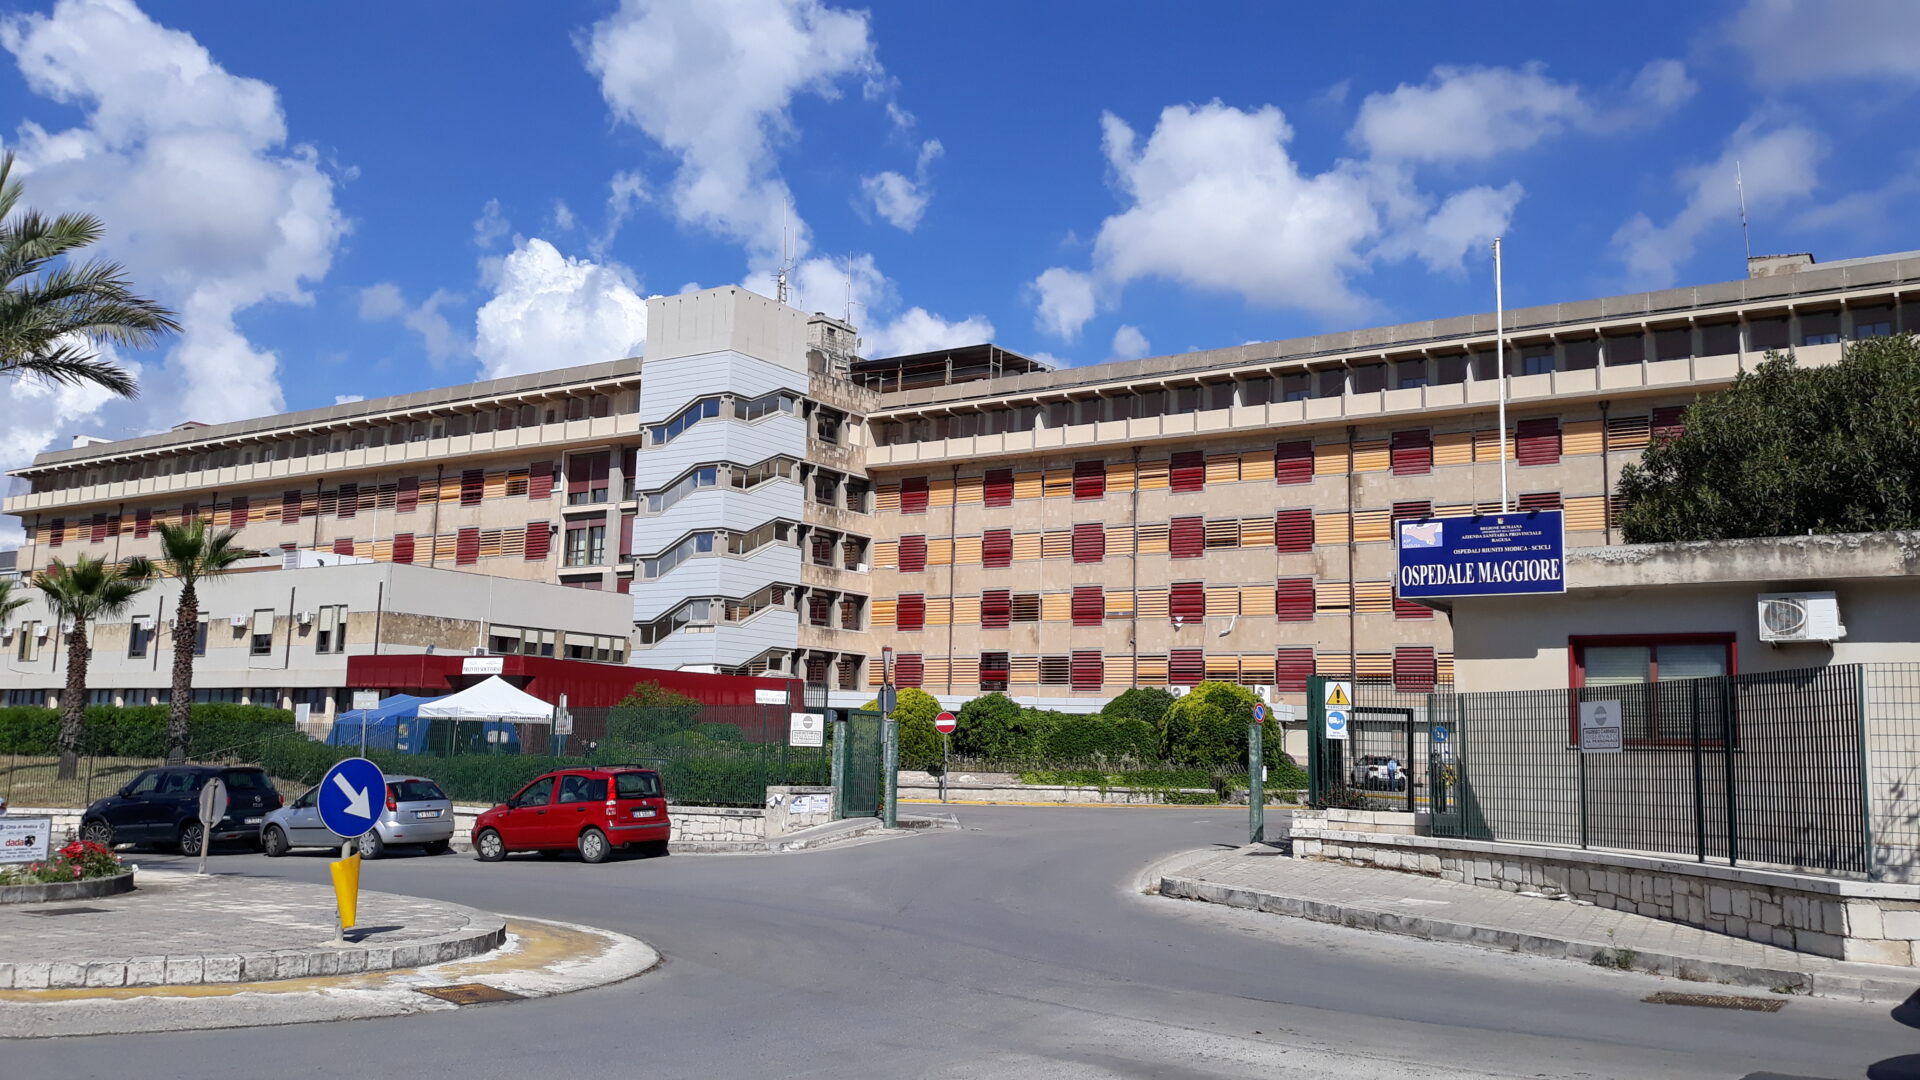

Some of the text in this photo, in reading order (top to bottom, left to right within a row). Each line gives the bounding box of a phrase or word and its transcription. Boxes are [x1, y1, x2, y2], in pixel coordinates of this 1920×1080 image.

[1453, 547, 1481, 555] OSPEDALI
[1402, 558, 1561, 587] OSPEDALE MAGGIORE
[5, 838, 24, 846] dada
